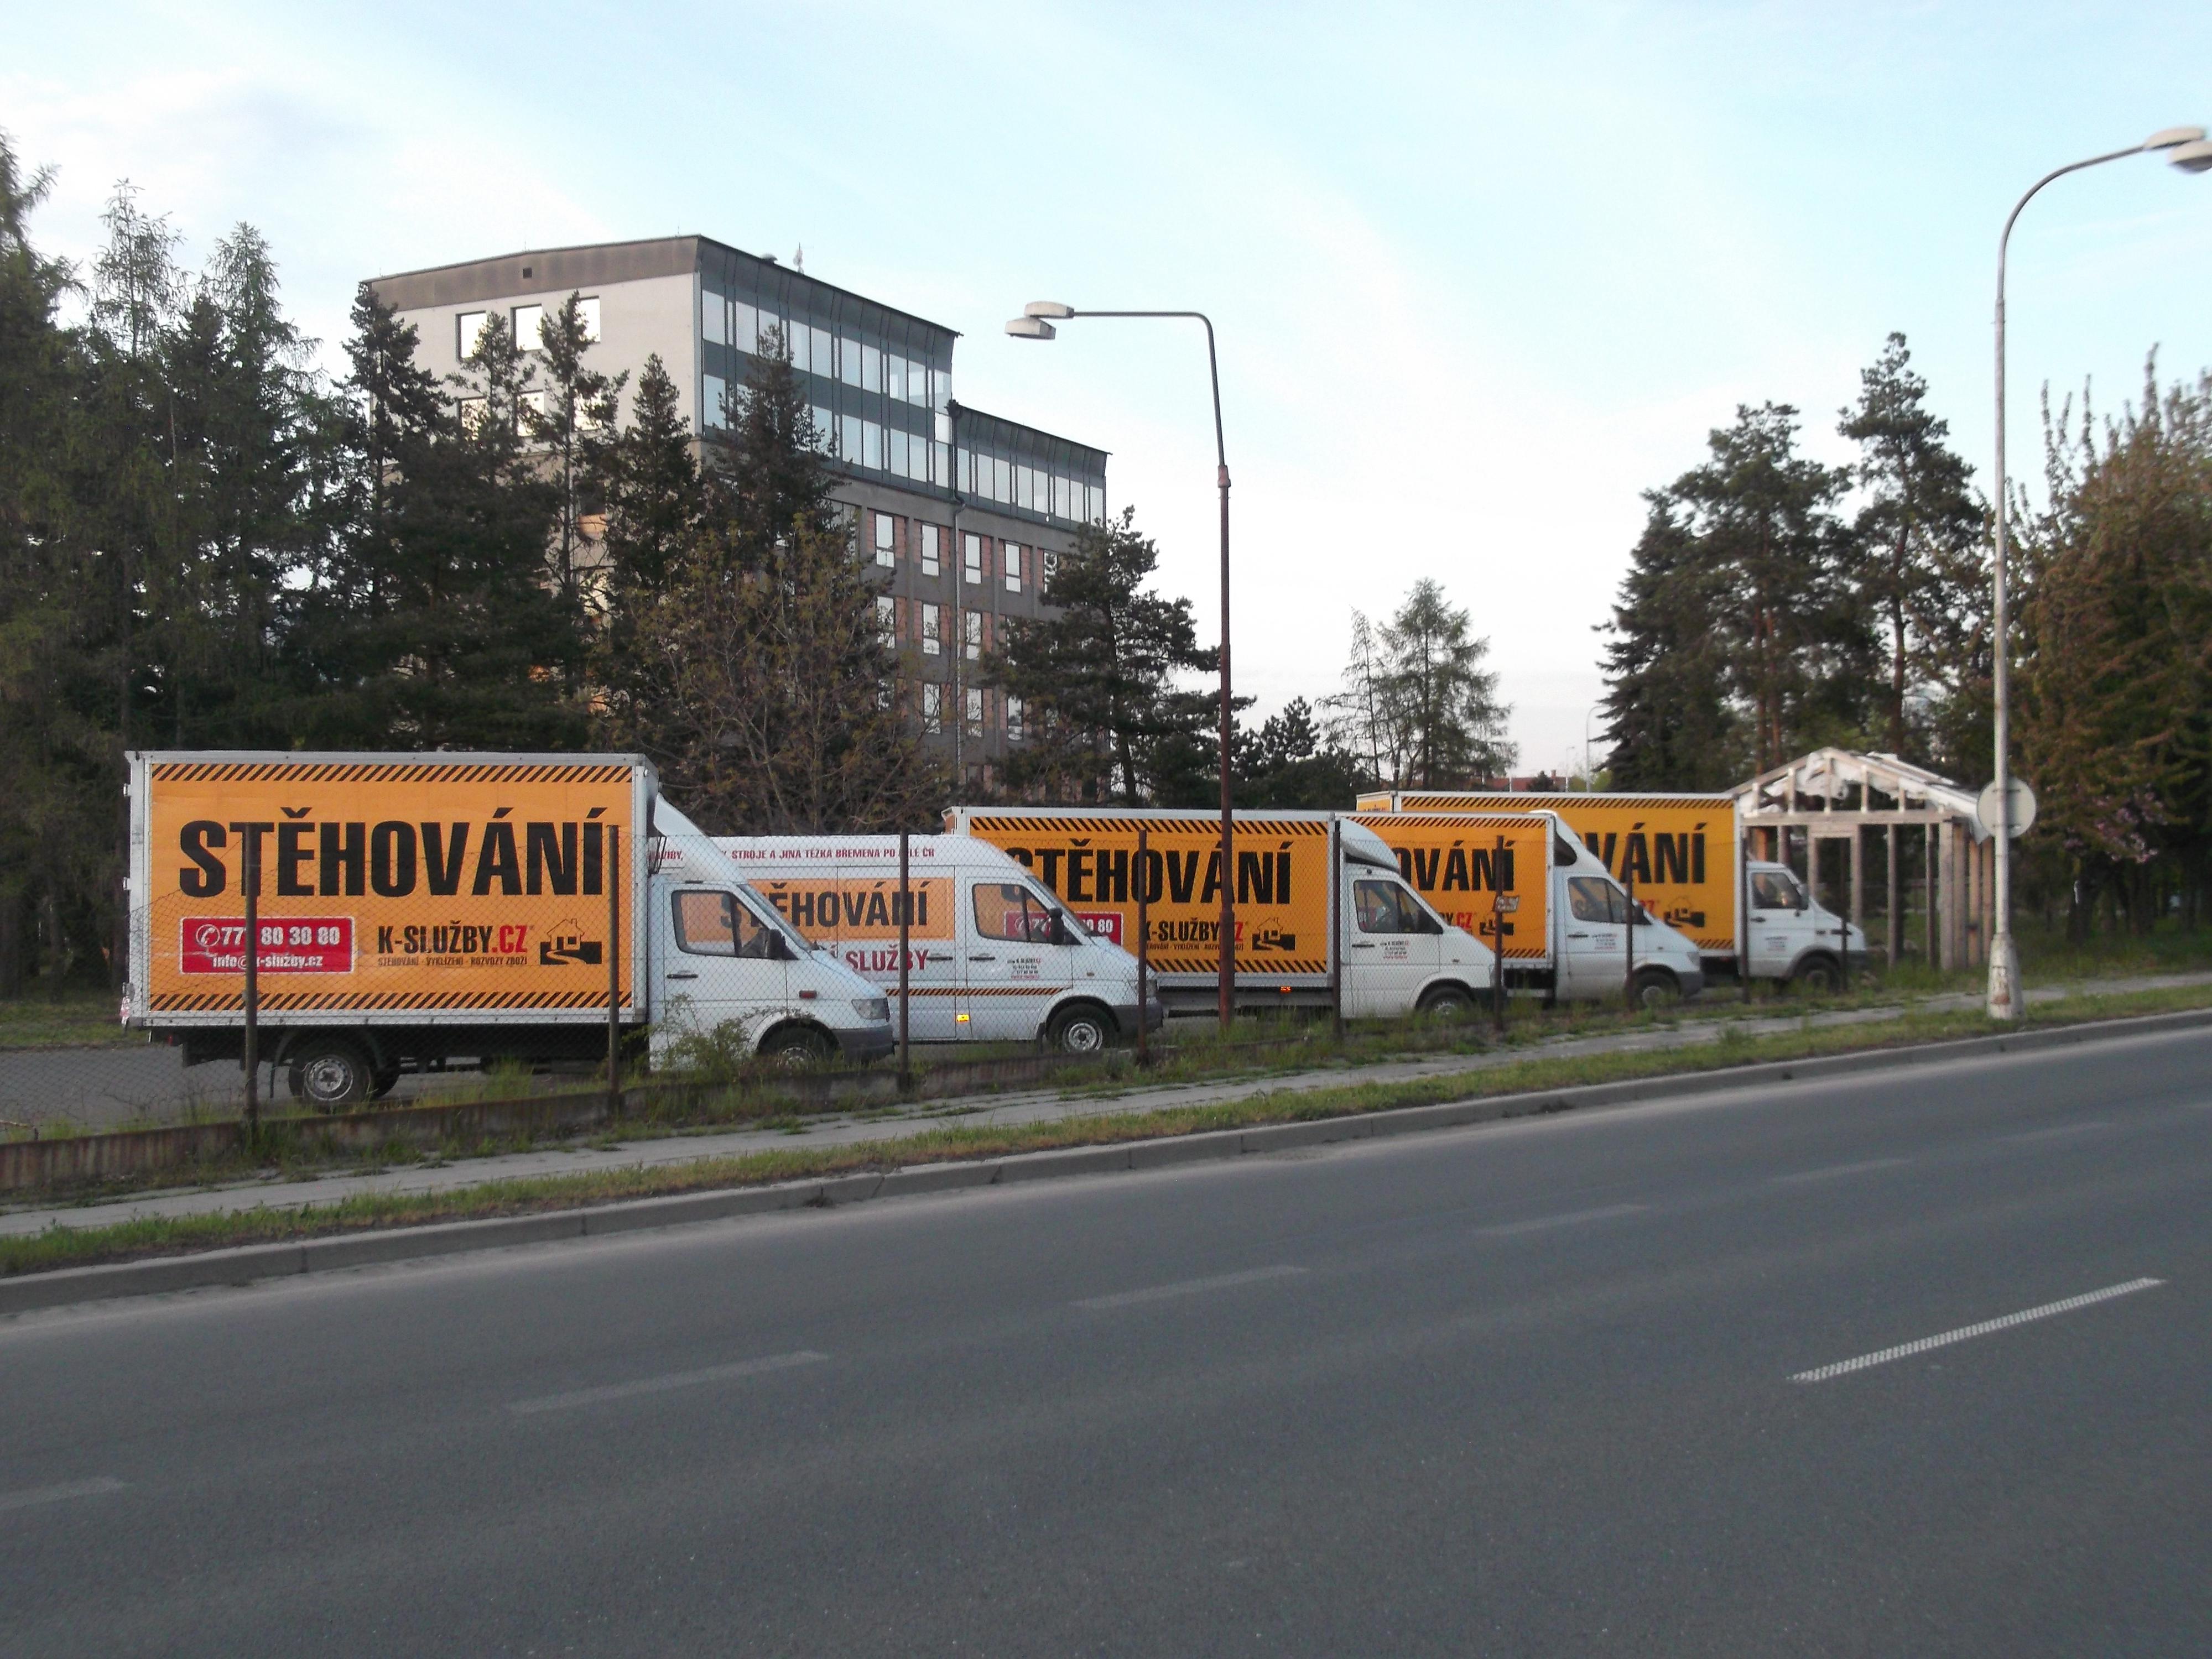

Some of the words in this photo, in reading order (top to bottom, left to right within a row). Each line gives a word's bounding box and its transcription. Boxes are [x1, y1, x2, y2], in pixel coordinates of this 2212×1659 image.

[180, 807, 607, 897] STĚHOVÁNÍ
[883, 849, 895, 857] PO
[1098, 919, 1113, 933] 80
[221, 926, 254, 945] 77
[261, 926, 284, 945] 80
[289, 926, 312, 946] 30
[318, 926, 340, 946] 80
